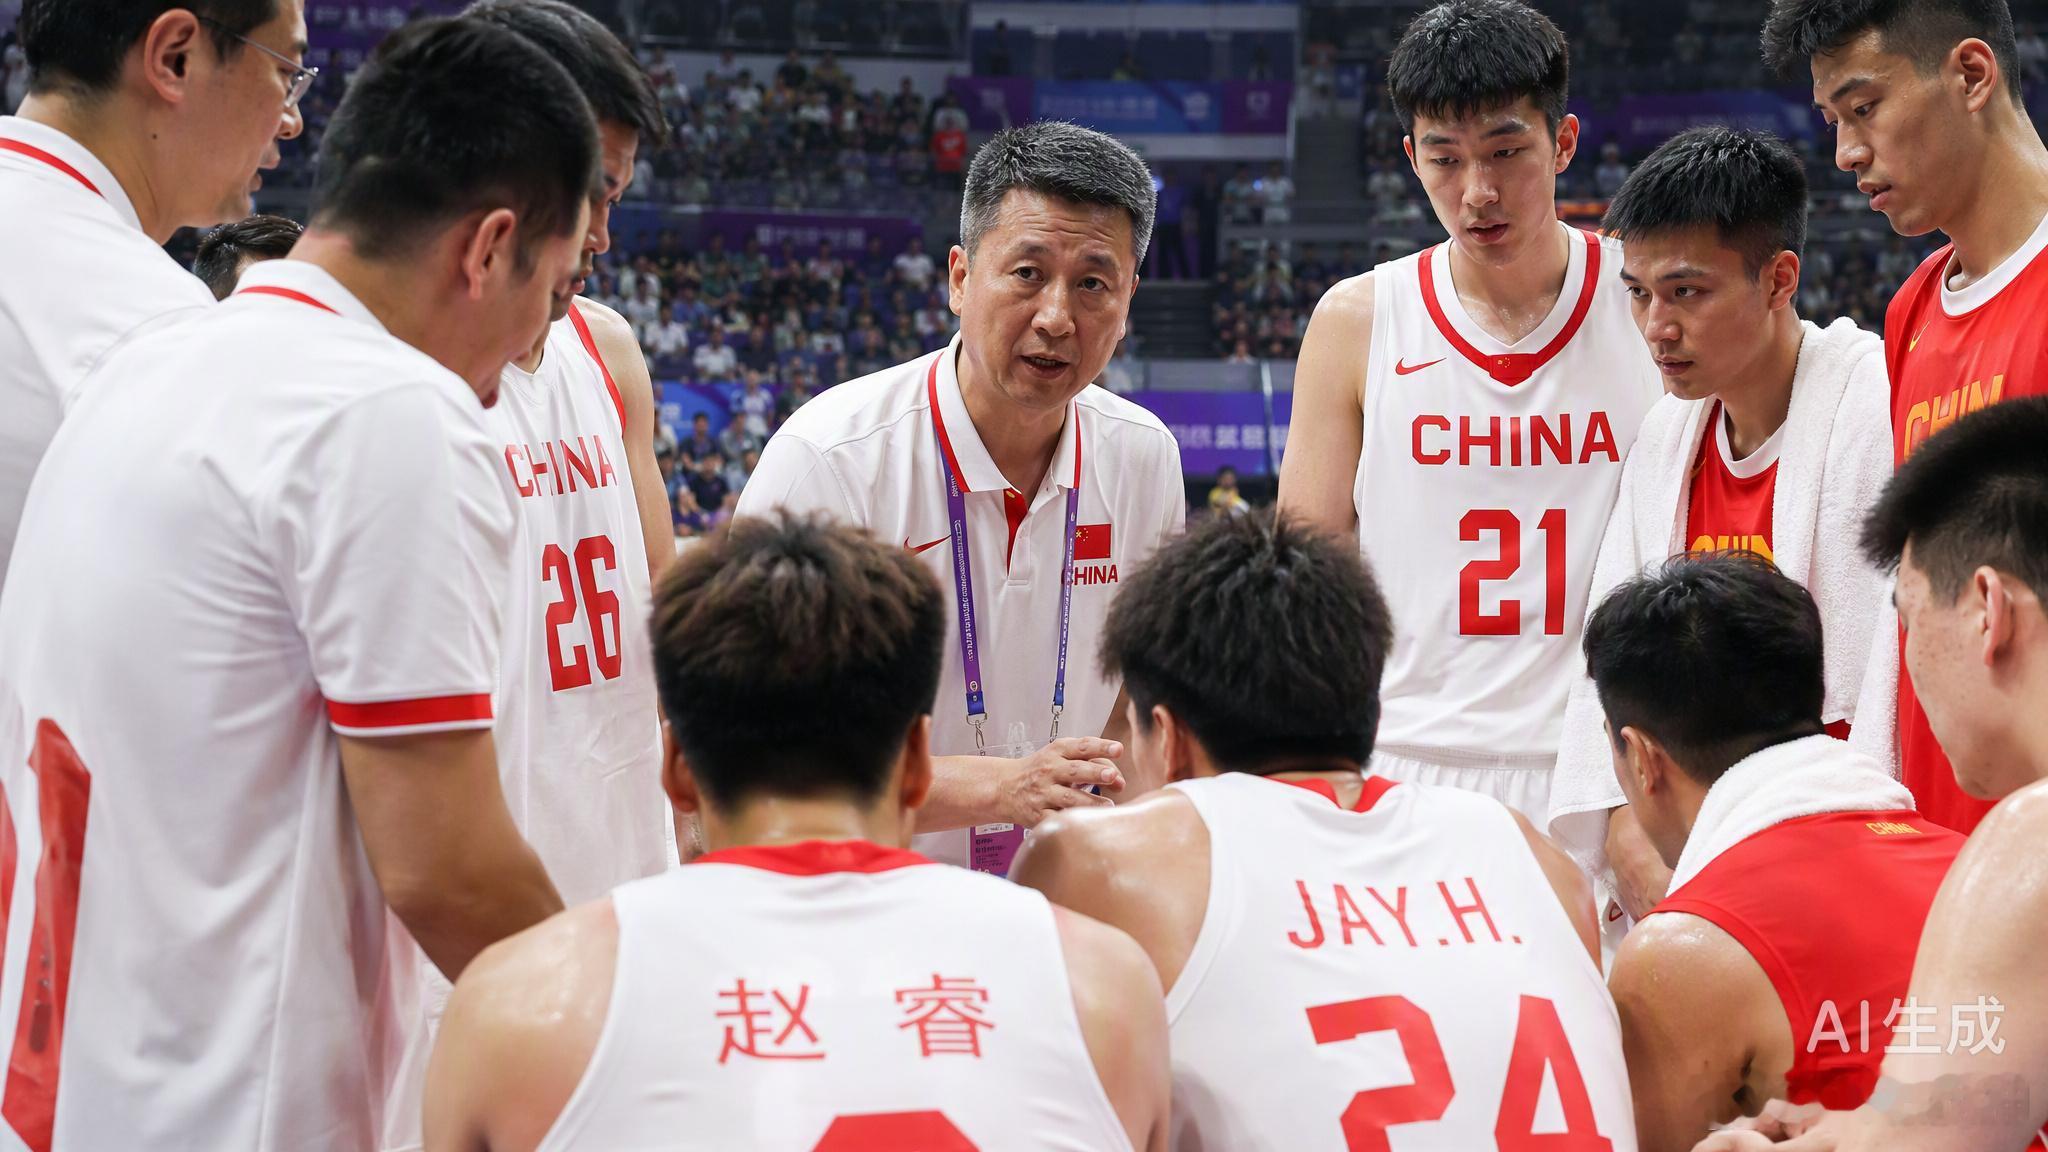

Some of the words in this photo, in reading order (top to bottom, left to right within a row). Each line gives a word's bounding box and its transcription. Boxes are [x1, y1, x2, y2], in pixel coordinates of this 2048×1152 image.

[504, 435, 618, 498] CHINA
[1411, 411, 1620, 467] CHINA
[1458, 508, 1567, 636] 21
[541, 534, 622, 692] 26
[1287, 877, 1523, 949] JAY.H.
[715, 974, 995, 1064] 赵睿
